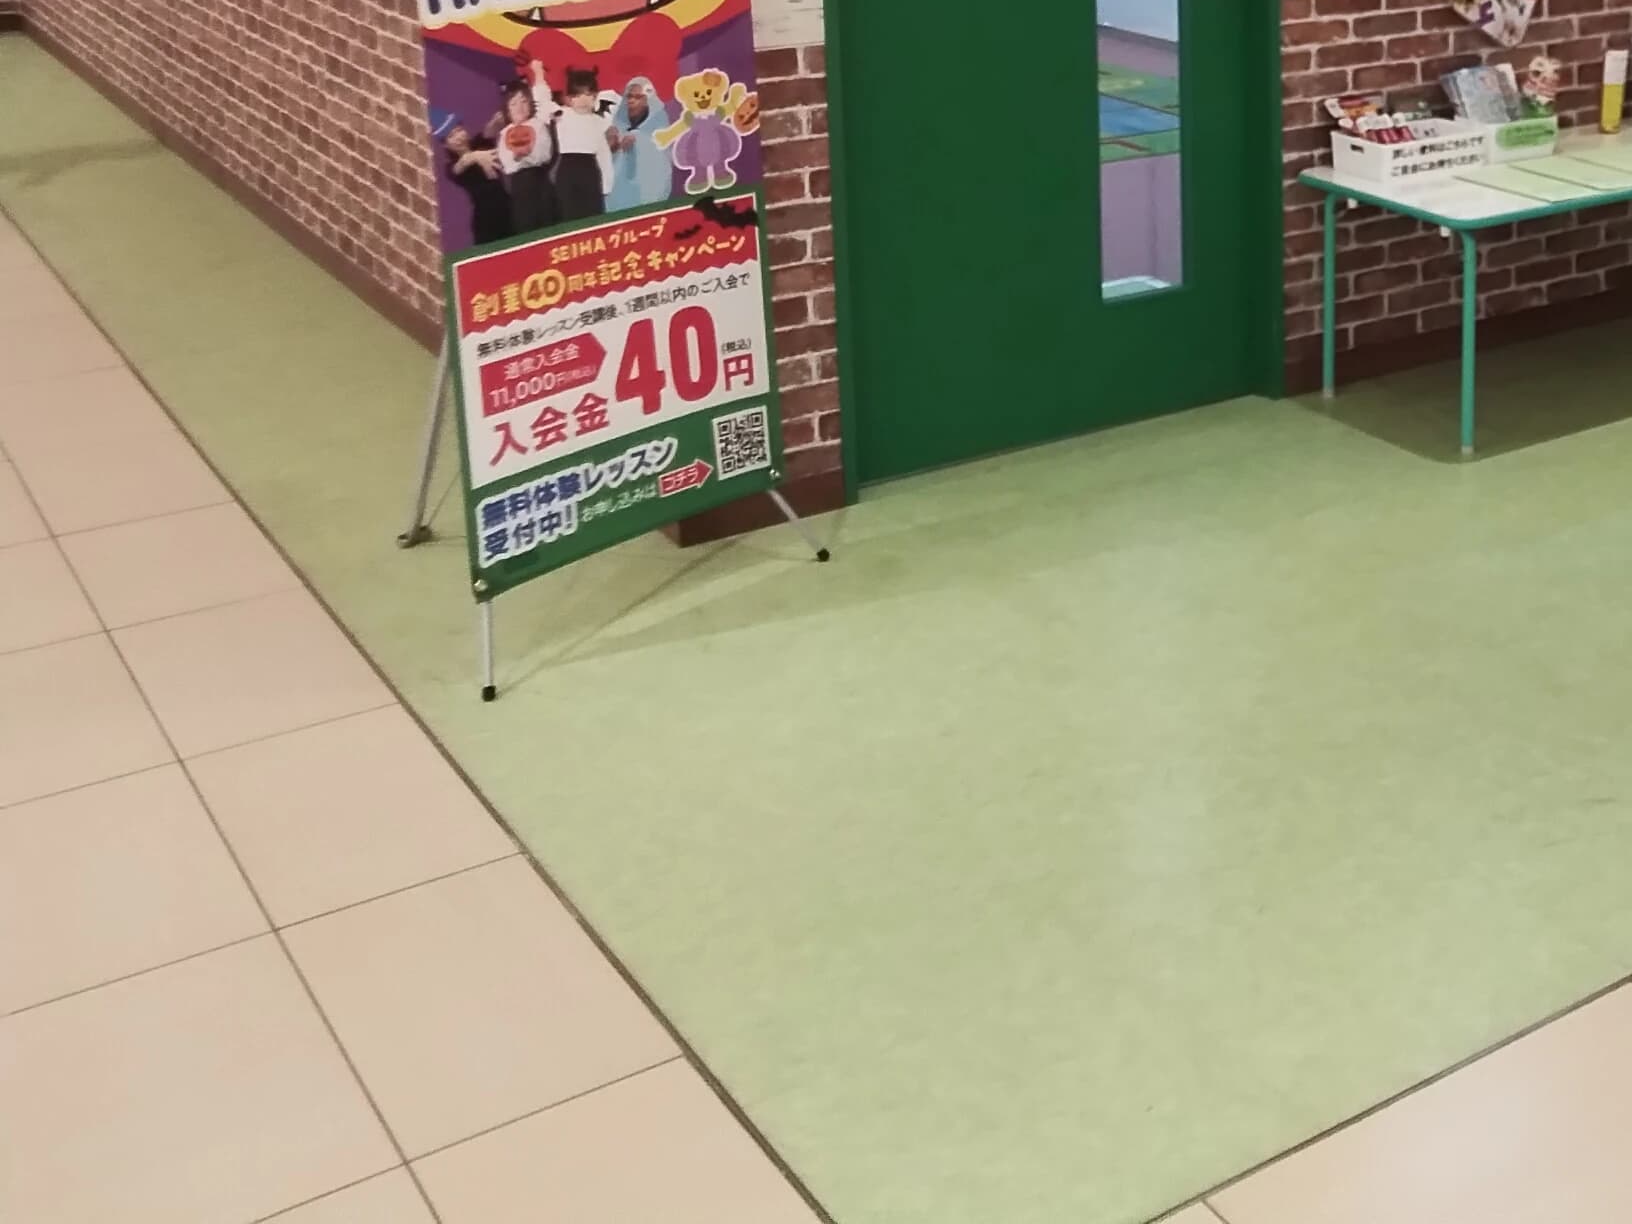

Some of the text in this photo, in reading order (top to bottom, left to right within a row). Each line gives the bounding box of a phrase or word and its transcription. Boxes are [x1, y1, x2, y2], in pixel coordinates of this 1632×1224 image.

[481, 437, 677, 526] 無料体験レッスン
